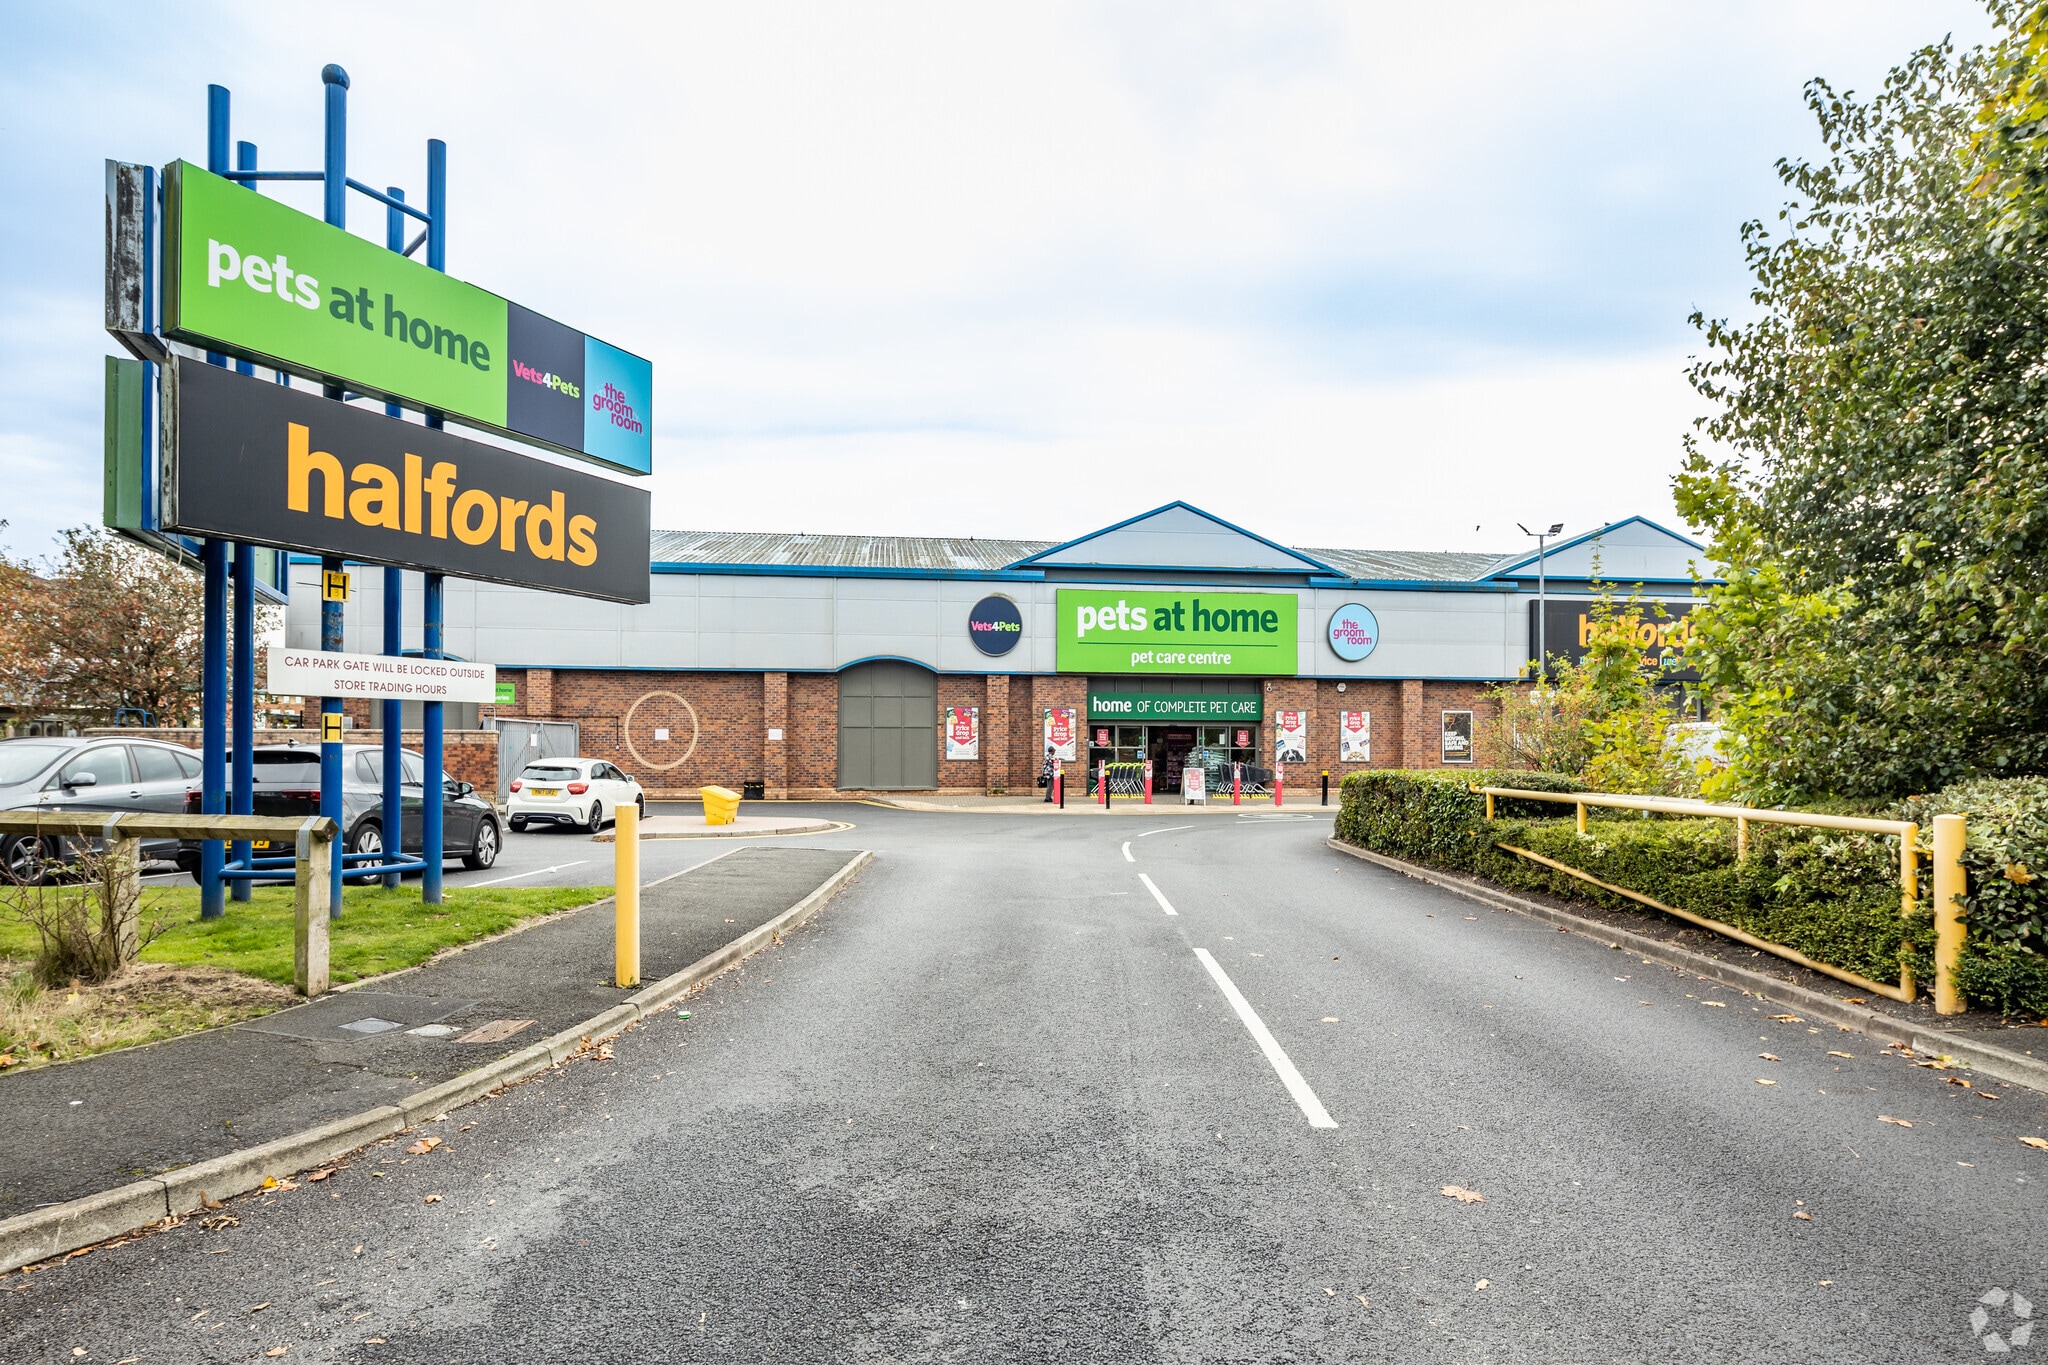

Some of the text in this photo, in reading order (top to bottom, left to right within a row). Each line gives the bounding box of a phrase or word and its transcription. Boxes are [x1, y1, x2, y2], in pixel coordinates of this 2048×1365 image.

[208, 238, 491, 372] pets at home
[513, 359, 580, 399] Vets4Pets
[604, 382, 626, 404] the
[593, 393, 633, 419] groom
[611, 412, 643, 434] room
[287, 422, 599, 567] halfords
[327, 573, 347, 600] H
[971, 621, 1020, 632] Vets4Pets
[1077, 599, 1279, 638] pets at home
[1342, 619, 1359, 629] the
[1333, 628, 1365, 640] groom
[1347, 636, 1373, 645] room
[284, 656, 485, 679] CAR PARK GATE WILL BE LOCKED OUTSIDE
[1131, 650, 1231, 667] pet care centre
[334, 680, 447, 695] STORE TRADING HOURS
[1093, 696, 1257, 714] home OF COMPLETE PET CARE
[324, 715, 342, 740] H
